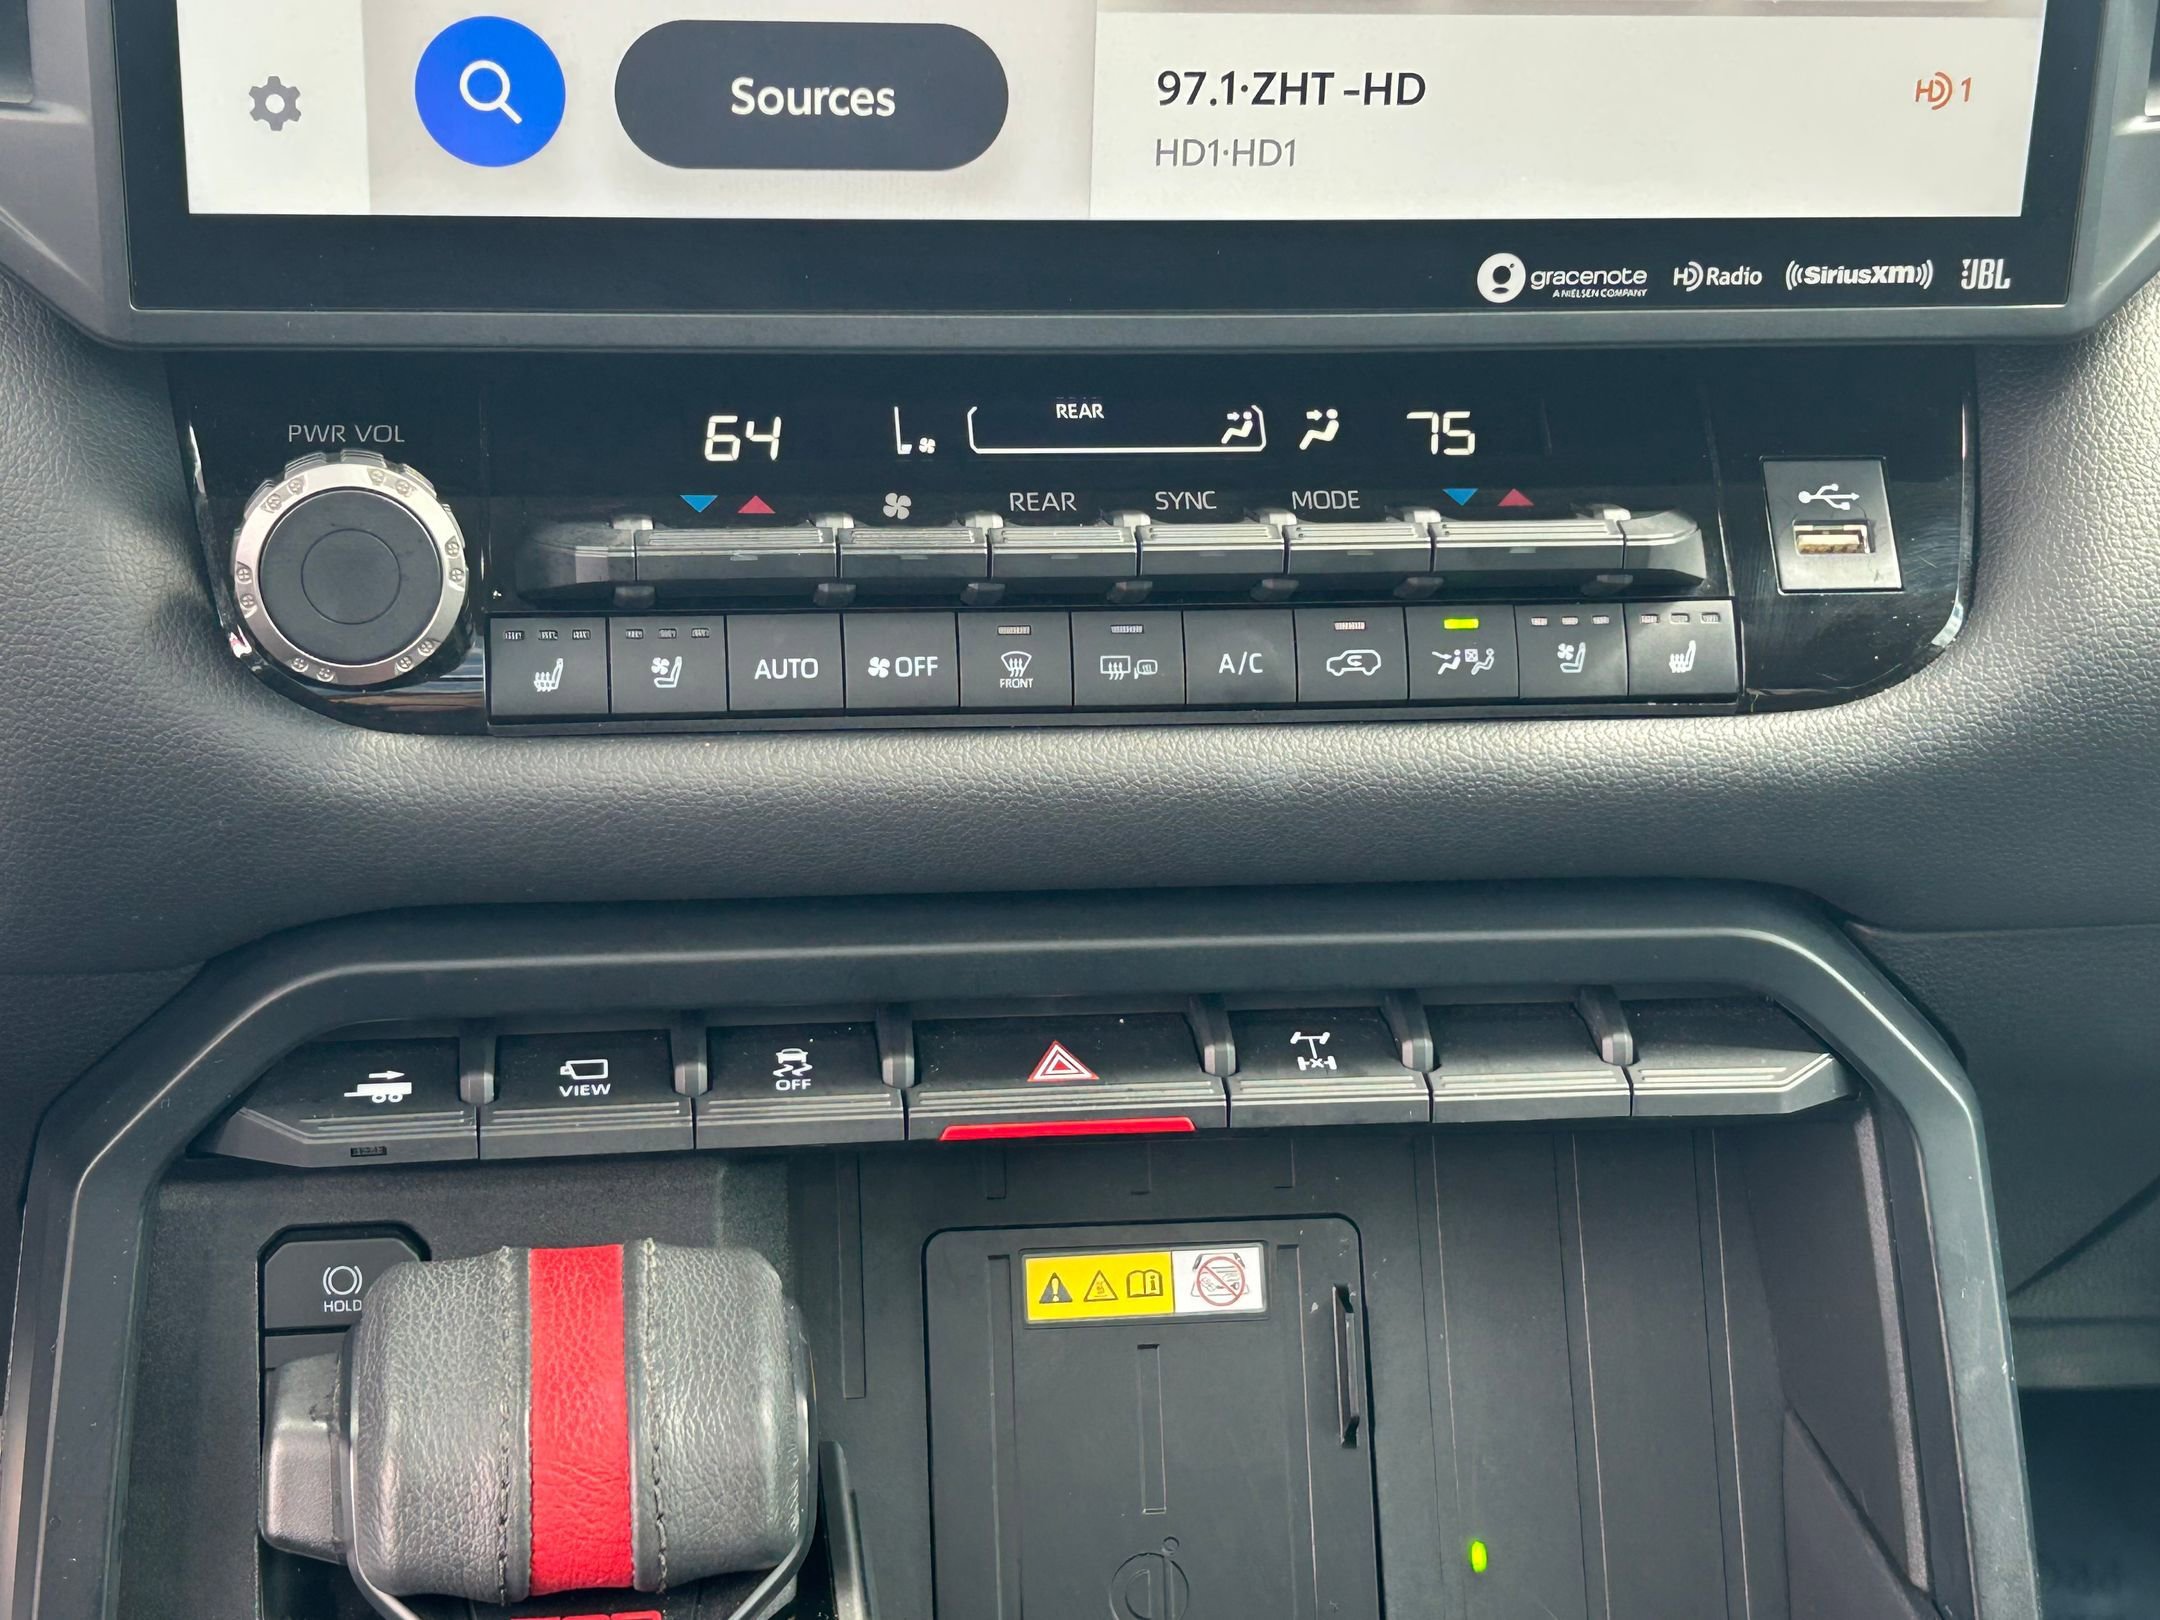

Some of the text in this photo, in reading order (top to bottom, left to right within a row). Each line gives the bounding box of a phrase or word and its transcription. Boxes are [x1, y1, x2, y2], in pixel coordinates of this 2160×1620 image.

[731, 76, 896, 117] Sources
[1343, 72, 1426, 106] -HD
[1961, 77, 1972, 102] 1
[1530, 267, 1648, 291] gracenote
[1705, 264, 1763, 286] Radio
[1961, 258, 2011, 290] JBL
[1561, 288, 1600, 298] NIELSEN
[1600, 287, 1648, 298] COMPANY
[1055, 403, 1104, 420] REAR
[288, 424, 405, 443] PWR VOL
[704, 415, 782, 462] 64
[1406, 411, 1476, 456] 75
[1009, 492, 1077, 512] REAR
[1154, 491, 1217, 510] SYNC
[1291, 490, 1360, 510] MODE
[754, 658, 819, 680] AUTO
[894, 656, 939, 677] OFF
[1219, 652, 1263, 675] A/C
[999, 678, 1034, 689] FRONT
[559, 1084, 611, 1096] VIEW
[775, 1078, 811, 1091] OFF
[323, 1299, 362, 1313] HOLD
